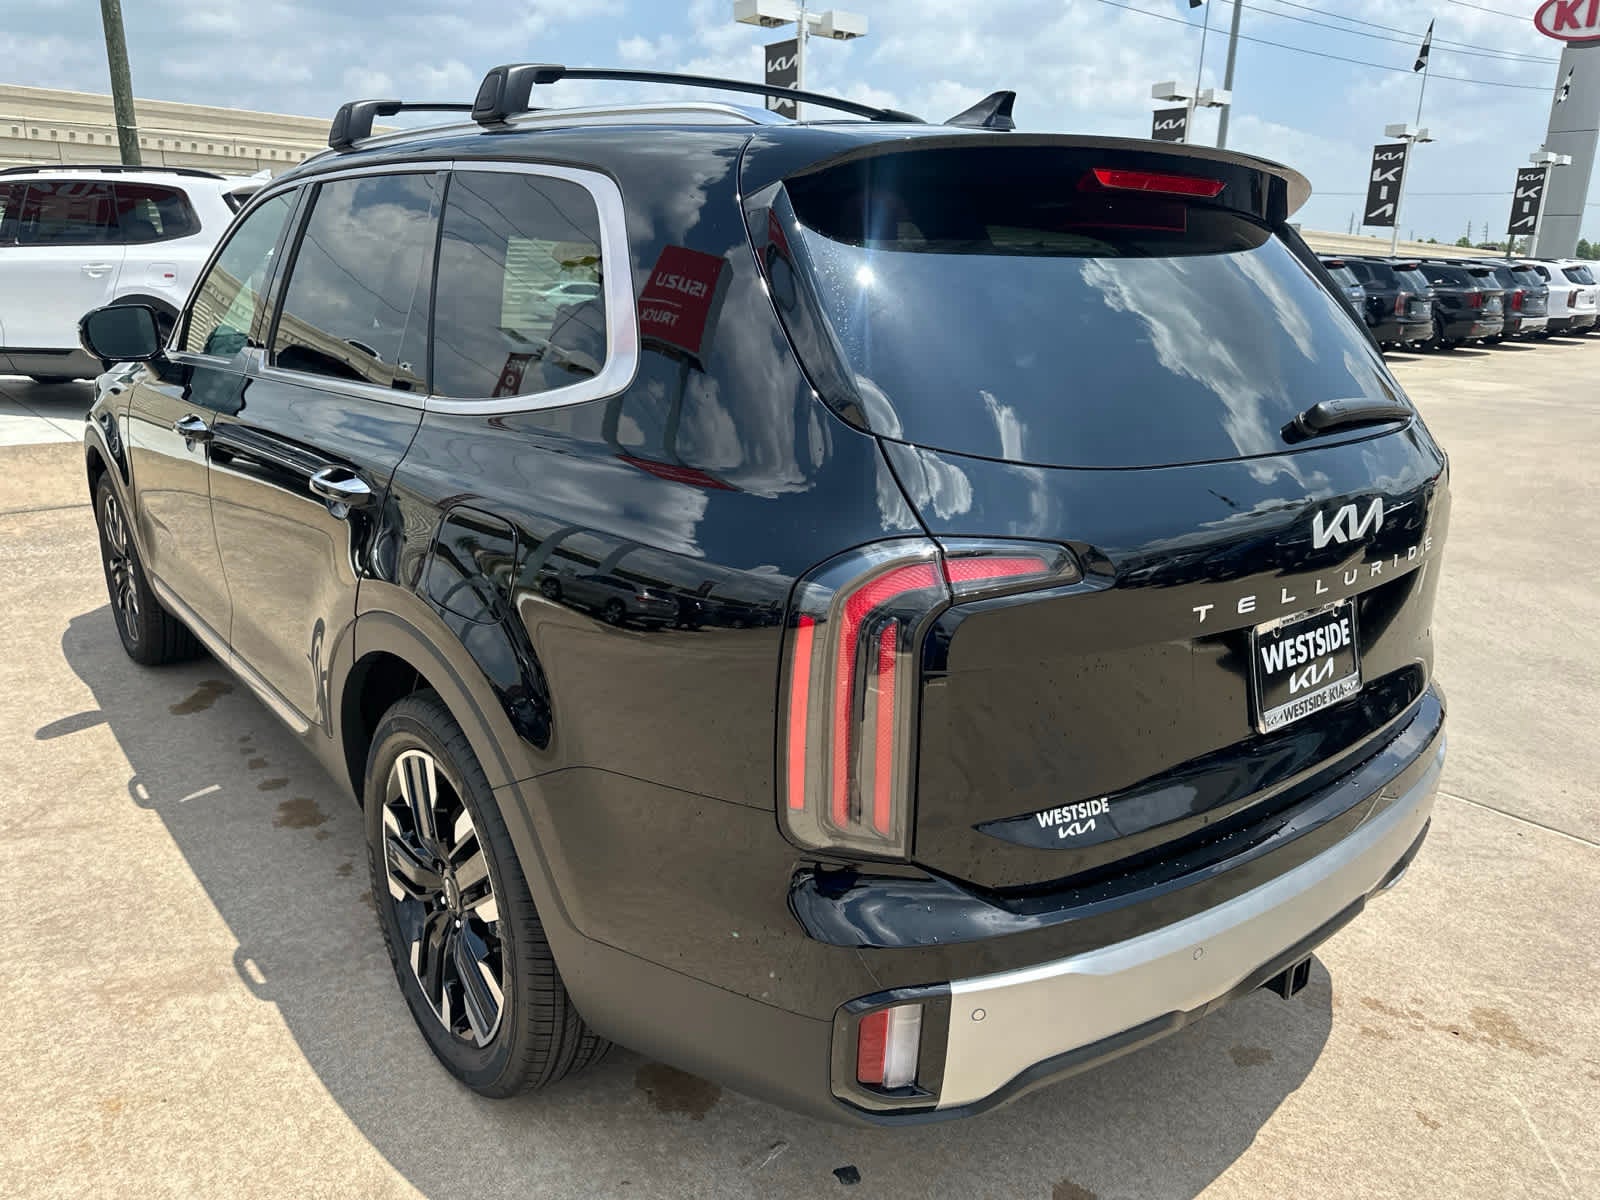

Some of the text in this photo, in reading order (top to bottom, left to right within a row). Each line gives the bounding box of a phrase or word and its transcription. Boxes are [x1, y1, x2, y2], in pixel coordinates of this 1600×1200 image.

[1553, 0, 1600, 31] KI
[767, 54, 799, 72] KIA
[1154, 118, 1185, 130] KIA
[1374, 151, 1404, 161] KIA
[1367, 166, 1402, 217] KIA
[1511, 185, 1542, 227] KIA
[1312, 497, 1384, 549] KIA
[1193, 536, 1433, 623] TELLURIDE
[1261, 618, 1351, 674] WESTSIDE
[1289, 657, 1334, 694] KIA
[1283, 691, 1327, 721] WESTSIDE
[1328, 682, 1344, 701] KIA
[1036, 797, 1110, 828] WESTSIDE
[1058, 819, 1096, 839] KIA
